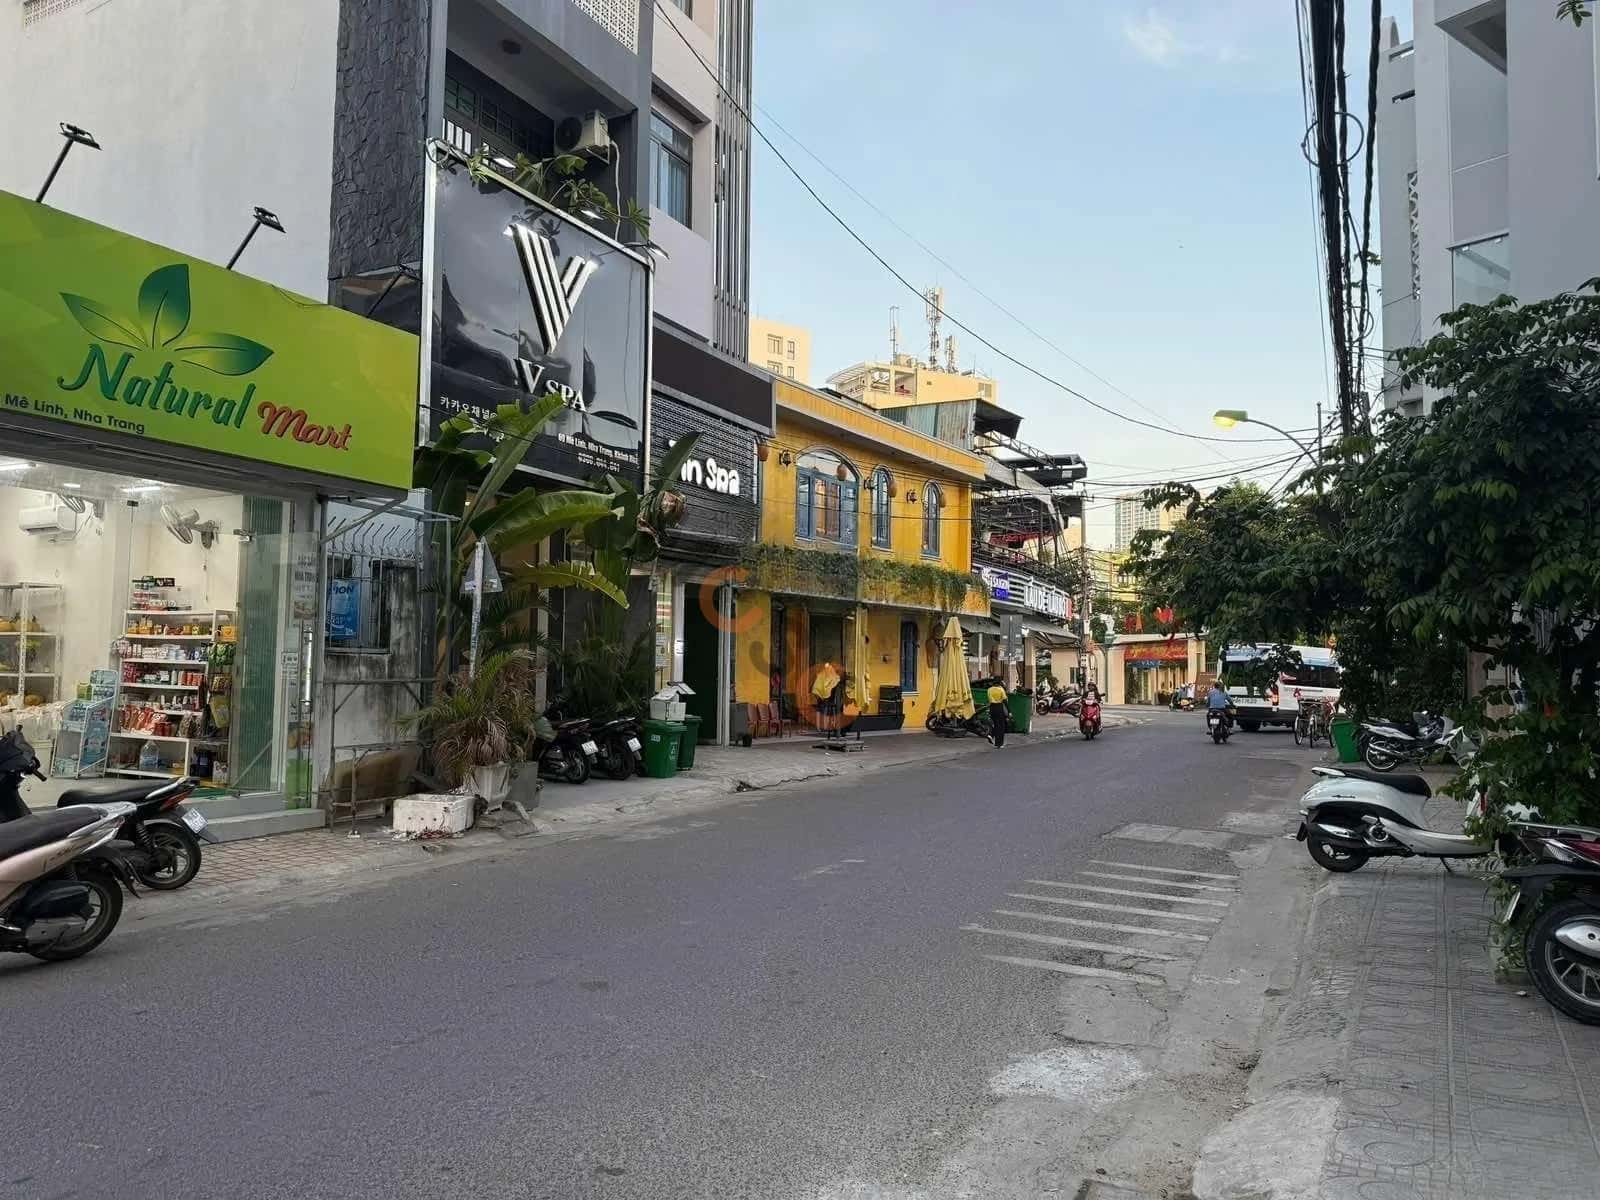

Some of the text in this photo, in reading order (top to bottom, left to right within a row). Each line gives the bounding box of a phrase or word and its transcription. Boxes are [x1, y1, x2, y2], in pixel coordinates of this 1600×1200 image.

[57, 343, 352, 451] Natural Mart
[519, 357, 587, 413] V SPA
[5, 393, 145, 434] Mê Linh, Nha Trang
[706, 457, 740, 496] Spa
